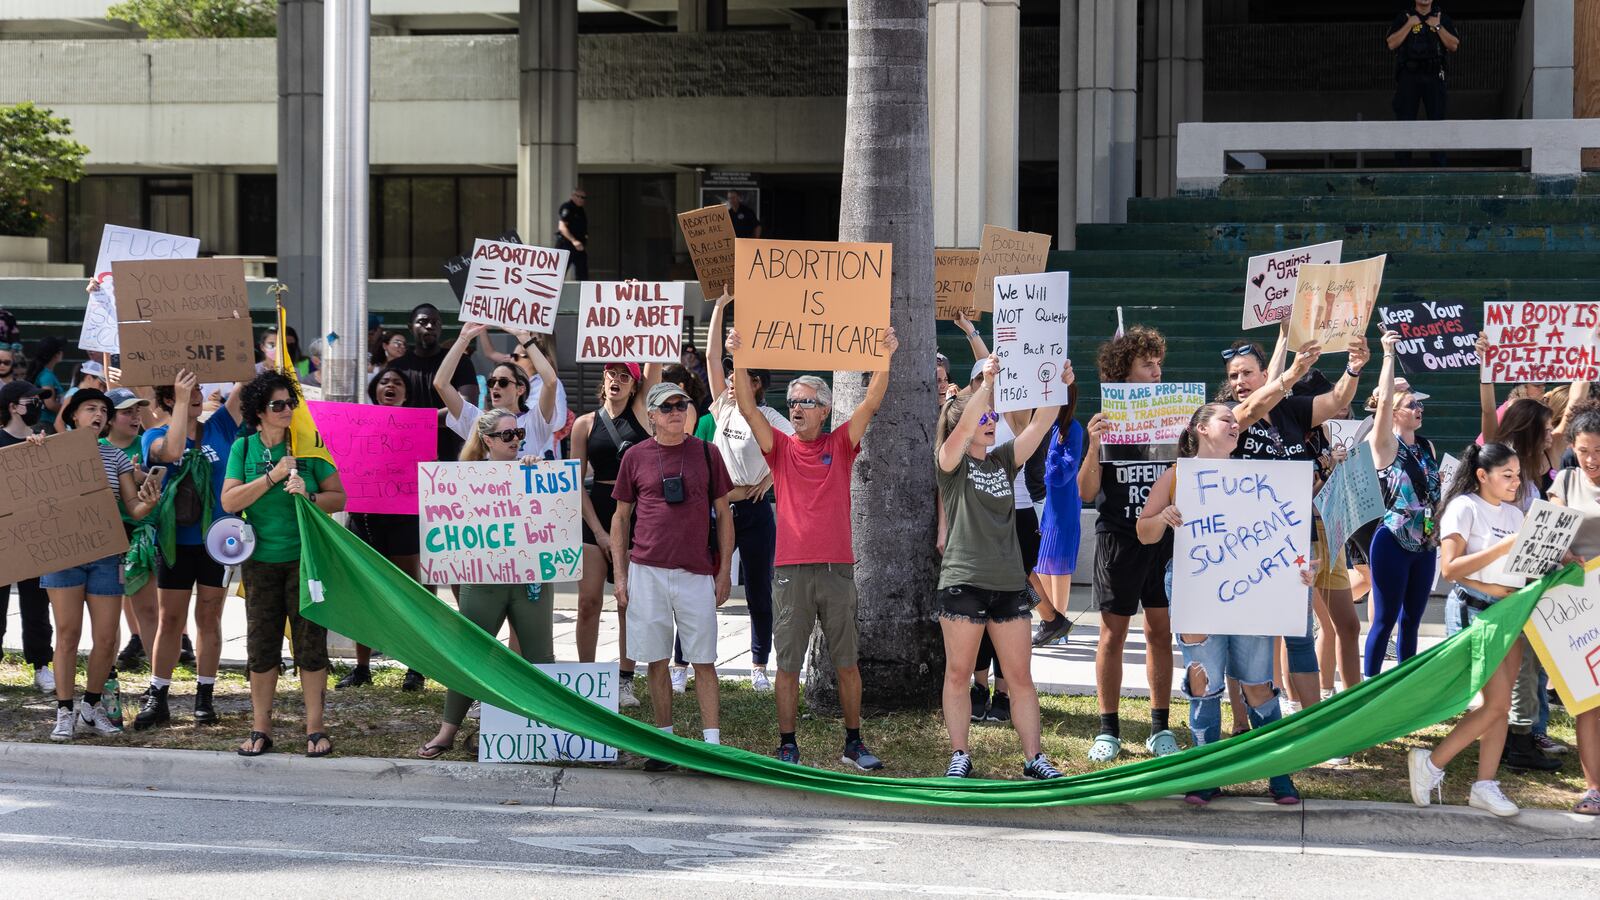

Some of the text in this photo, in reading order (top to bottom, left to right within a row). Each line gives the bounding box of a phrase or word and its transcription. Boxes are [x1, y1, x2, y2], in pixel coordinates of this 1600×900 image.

[683, 212, 725, 229] ABORTION
[107, 231, 188, 258] FUCK
[690, 239, 732, 256] RACIST
[474, 243, 561, 272] ABORTION
[748, 247, 884, 282] ABORTION
[981, 253, 1043, 269] AUTONOMY
[1267, 252, 1312, 280] Against
[131, 271, 179, 298] YOU
[504, 267, 523, 285] IS
[595, 283, 670, 303] I WILL
[802, 289, 826, 316] IS
[997, 283, 1019, 300] We
[1025, 283, 1047, 301] Will
[1264, 286, 1290, 302] Get
[135, 297, 177, 319] BAN
[462, 296, 553, 327] HEALTHCARE
[585, 304, 684, 328] AID & ABET
[996, 308, 1024, 324] NOT
[1379, 301, 1464, 326] Keep Your
[1486, 301, 1599, 328] MY BODY IS
[143, 327, 212, 344] YOU CAN
[1318, 319, 1340, 330] ARE
[1401, 318, 1465, 338] Rosaries
[1500, 323, 1565, 345] NOT A
[581, 334, 682, 358] ABORTION
[752, 320, 885, 358] HEALTHCARE
[996, 343, 1063, 357] Go Back To
[185, 344, 225, 362] SAFE
[1422, 350, 1481, 370] Ovaries
[1484, 344, 1600, 368] POLITICAL
[997, 367, 1018, 386] The
[1491, 362, 1600, 382] PLAYGROUND
[999, 386, 1028, 403] 1950's
[1103, 383, 1205, 401] YOU ARE PRO-LIFE
[1103, 393, 1205, 410] UNTIL THE BABIES ARE
[1101, 432, 1152, 444] DISABLED,
[1244, 437, 1264, 455] By
[6, 459, 101, 502] EXISTENCE
[421, 465, 458, 496] You
[520, 461, 580, 495] TRUST
[1195, 469, 1282, 505] FUCK
[1128, 485, 1152, 505] RO
[38, 496, 63, 519] OR
[425, 498, 542, 523] me with a
[1184, 514, 1228, 539] THE
[1535, 510, 1579, 530] MY BODY
[425, 521, 556, 553] CHOICE but
[1189, 500, 1302, 578] SUPREME
[1530, 525, 1549, 541] IS
[1545, 530, 1564, 545] NOT
[1563, 534, 1571, 547] A
[26, 531, 108, 566] RESISTANCE
[421, 559, 451, 585] You
[526, 567, 535, 582] a
[539, 547, 583, 581] BABY
[1535, 594, 1594, 632] Public
[481, 733, 549, 761] YOUR
